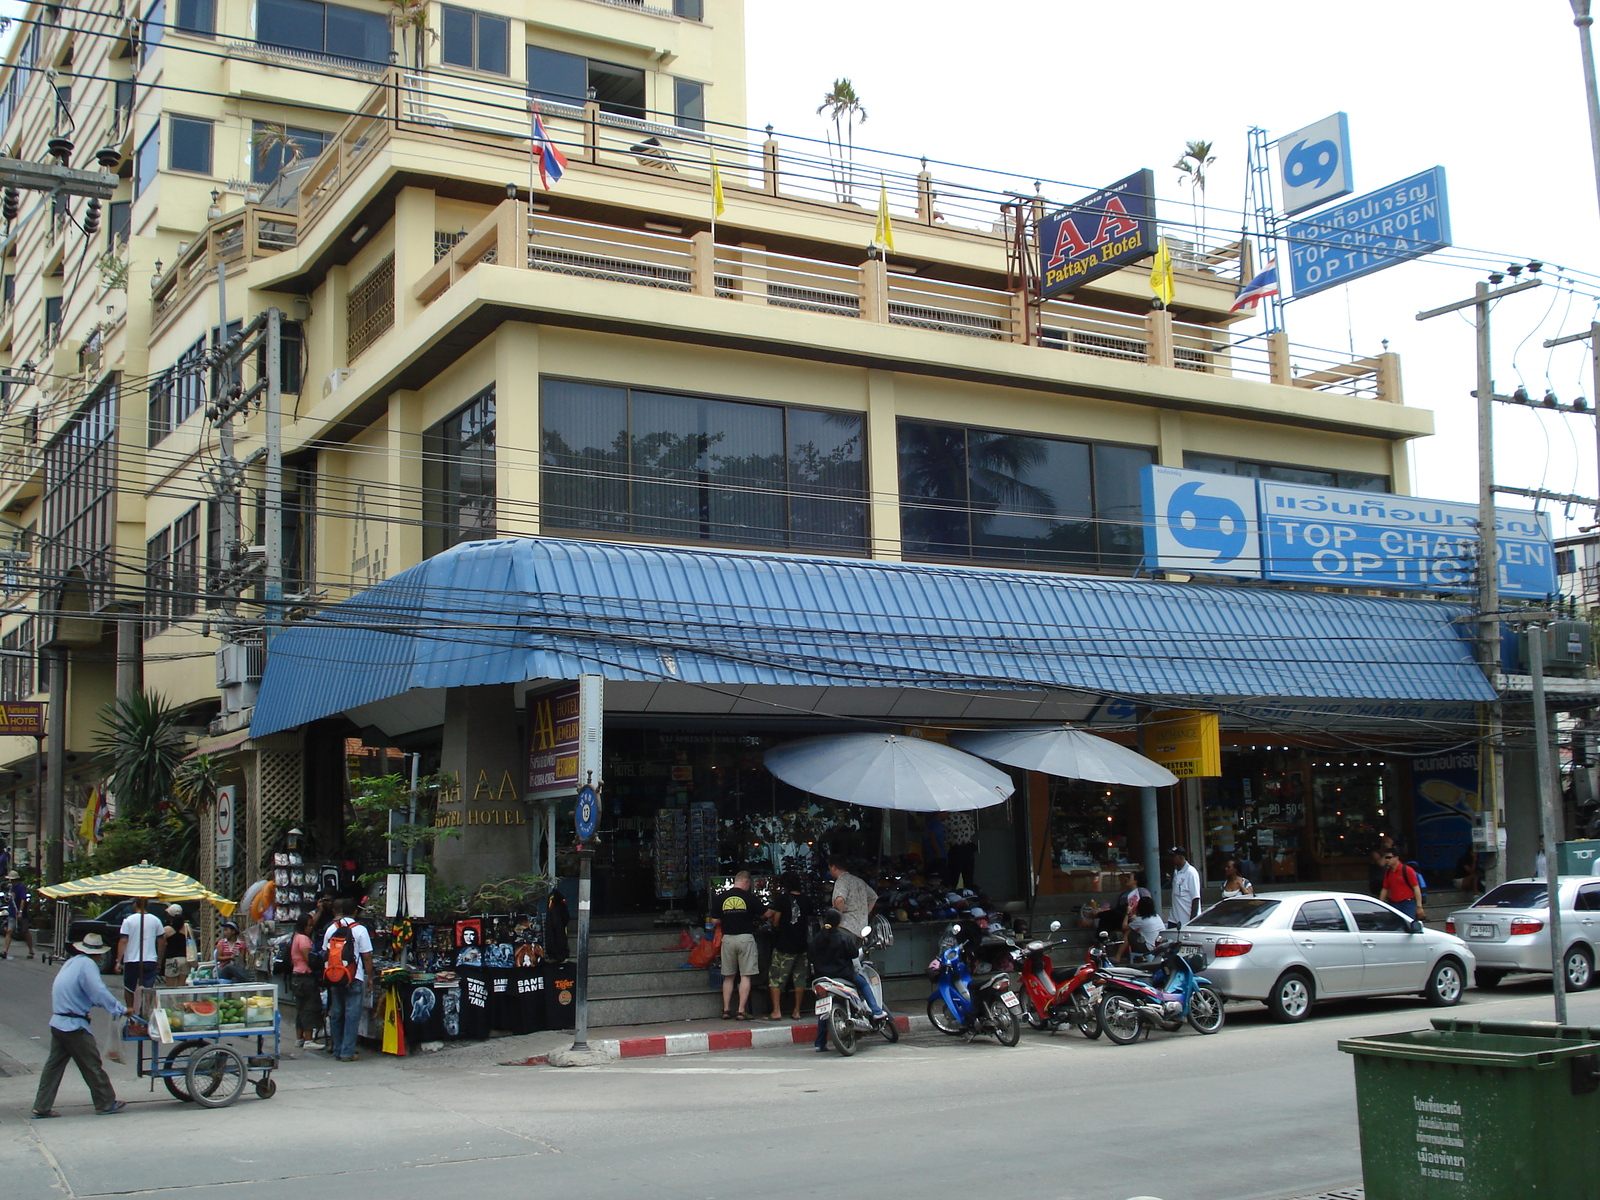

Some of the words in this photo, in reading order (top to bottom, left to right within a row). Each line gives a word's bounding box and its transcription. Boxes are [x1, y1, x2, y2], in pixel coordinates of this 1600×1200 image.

[1294, 243, 1330, 267] TOP
[1341, 202, 1436, 249] CHAROEN
[1045, 253, 1099, 287] Pattaya
[1101, 230, 1143, 262] Hotel
[1306, 229, 1427, 283] OPTICAL
[1278, 522, 1357, 549] TOP
[1312, 549, 1522, 588] OPTICL
[557, 698, 578, 717] HOTEL
[11, 717, 38, 725] HOTEL
[468, 809, 526, 825] HOTEL
[1573, 849, 1596, 859] TOT
[555, 979, 574, 990] Tiger
